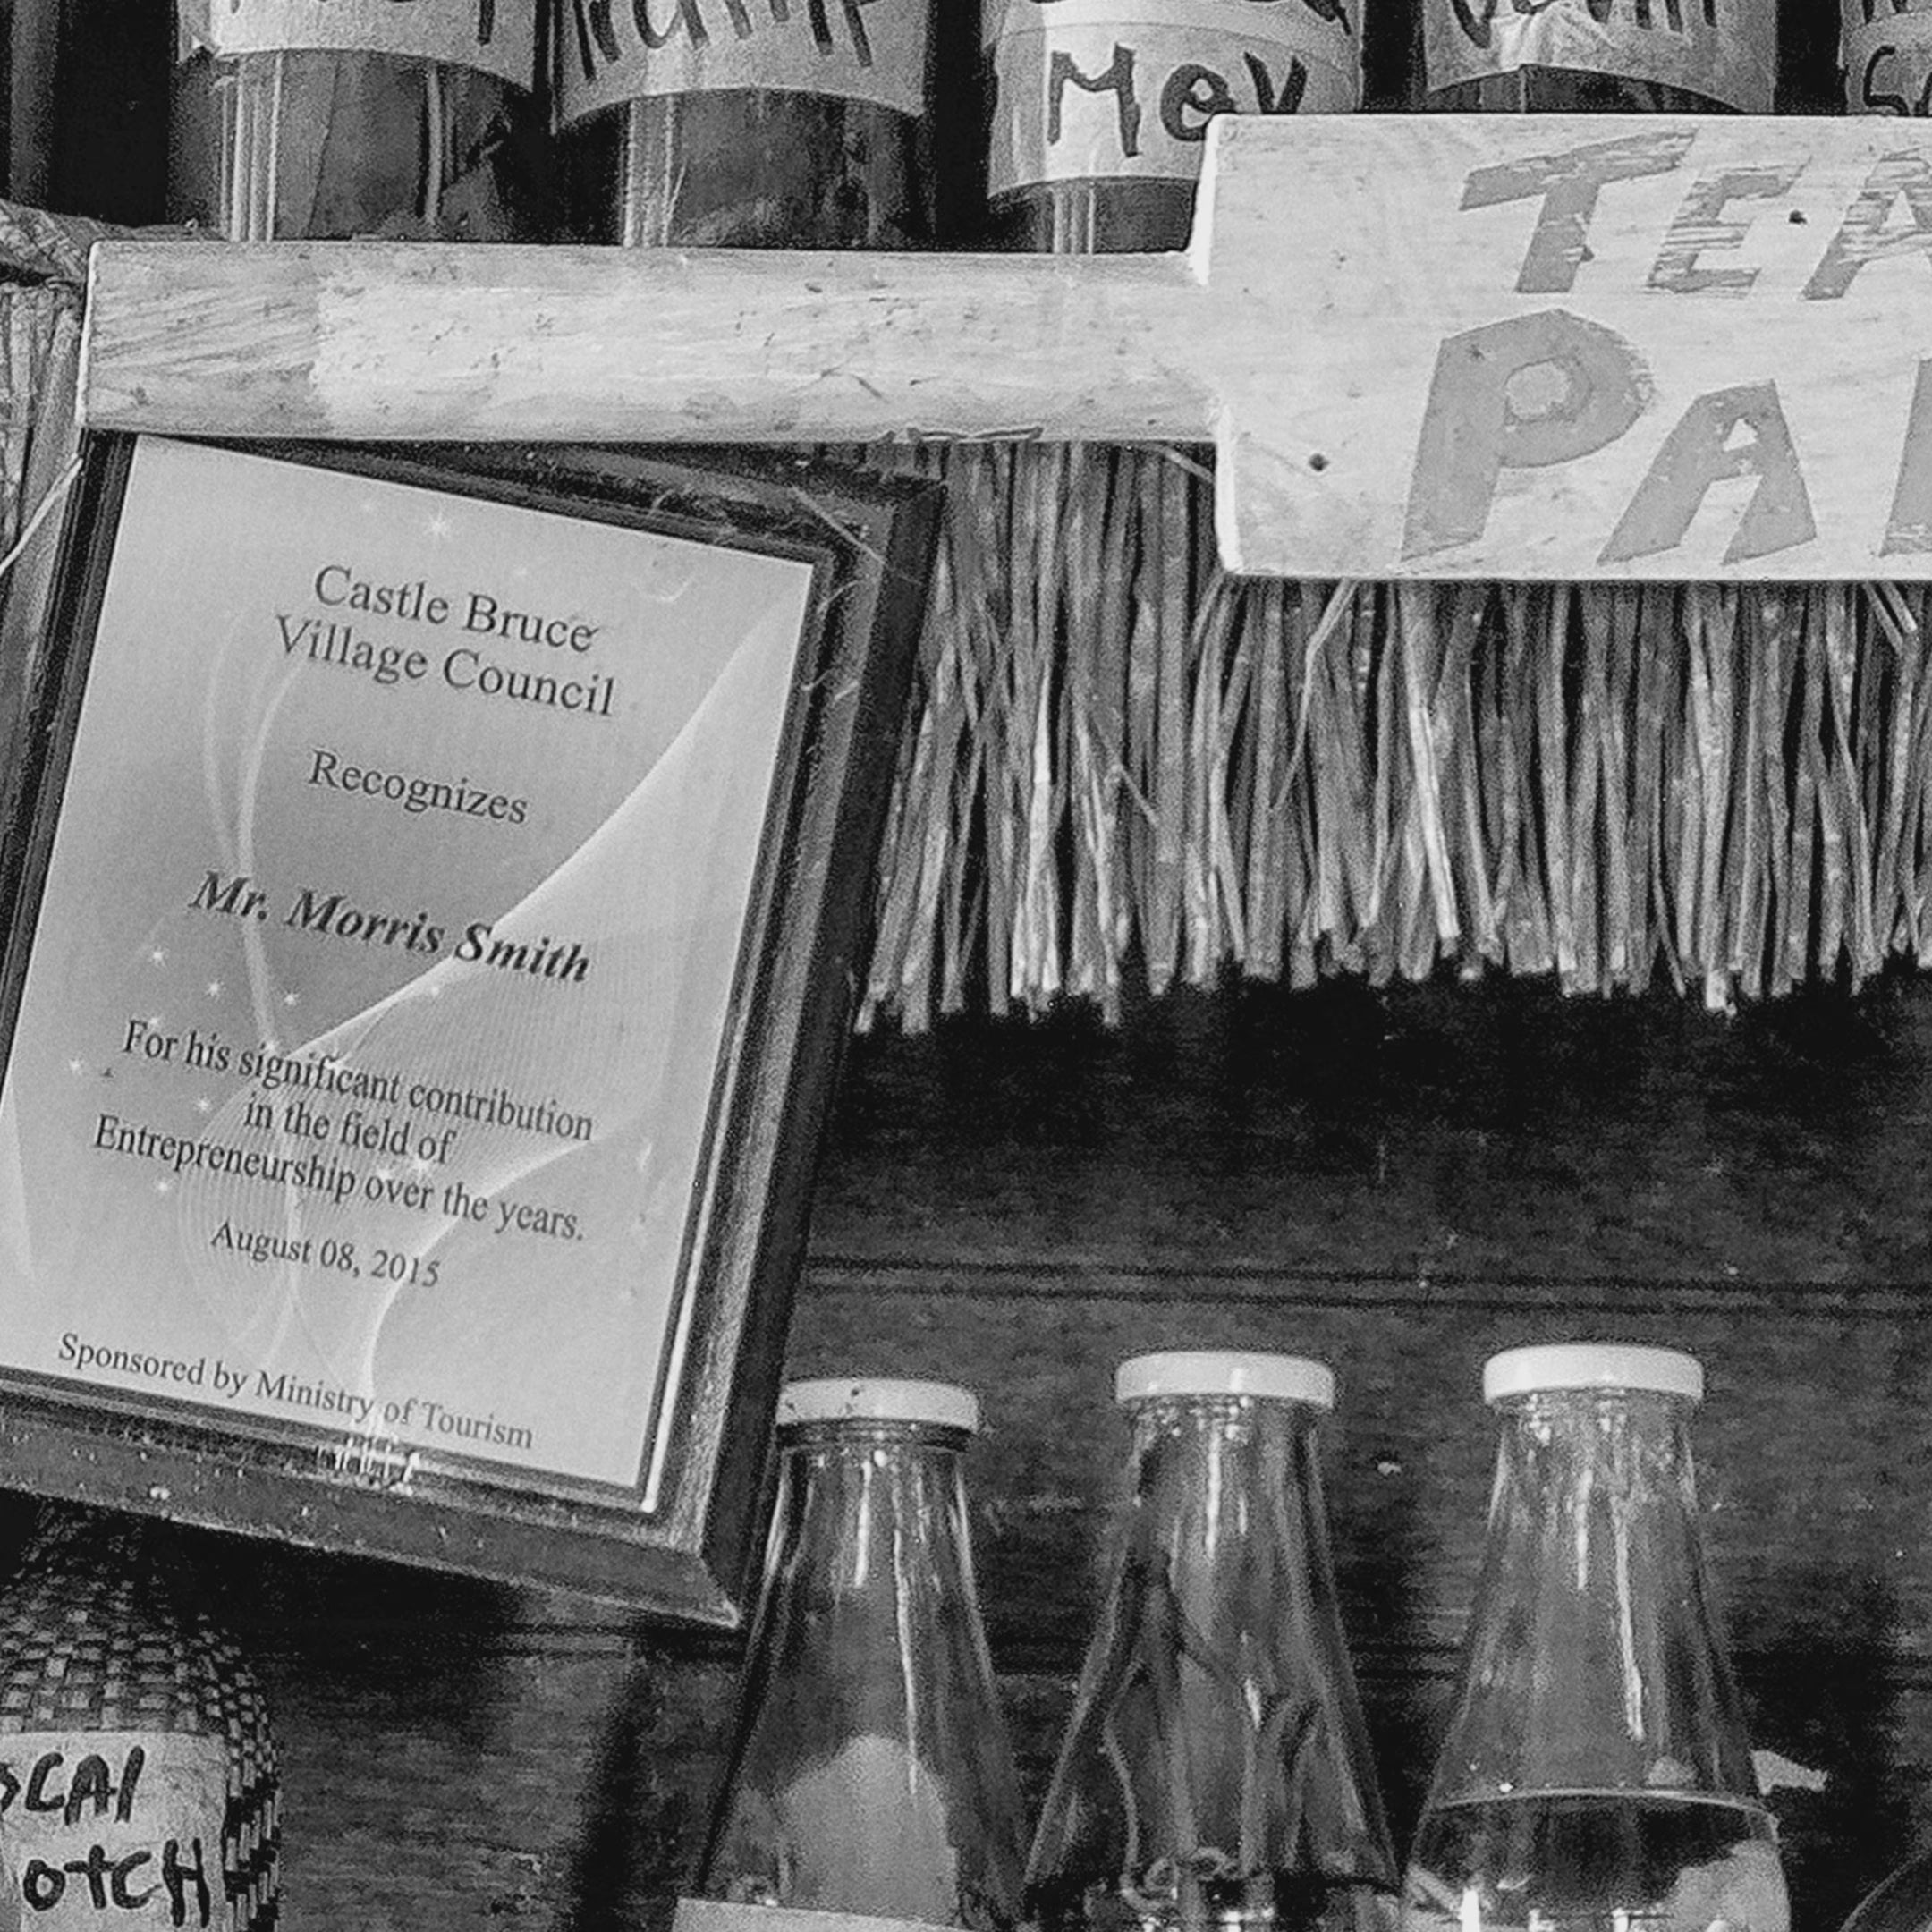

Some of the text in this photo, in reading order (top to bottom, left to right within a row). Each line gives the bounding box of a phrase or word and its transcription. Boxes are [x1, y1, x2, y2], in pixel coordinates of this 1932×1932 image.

[315, 565, 596, 652] Castle Bruce
[276, 614, 614, 716] Village Council
[308, 750, 528, 824] Recognizes
[188, 871, 591, 982] Mr. Morris Smith
[123, 1020, 593, 1142] For his significant contribution
[244, 1092, 457, 1165] in the field of
[94, 1114, 584, 1241] Entrepreneurship over the years.
[211, 1216, 442, 1288] August 08, 2015
[57, 1332, 535, 1451] Sponsored by Ministry of Tourism
